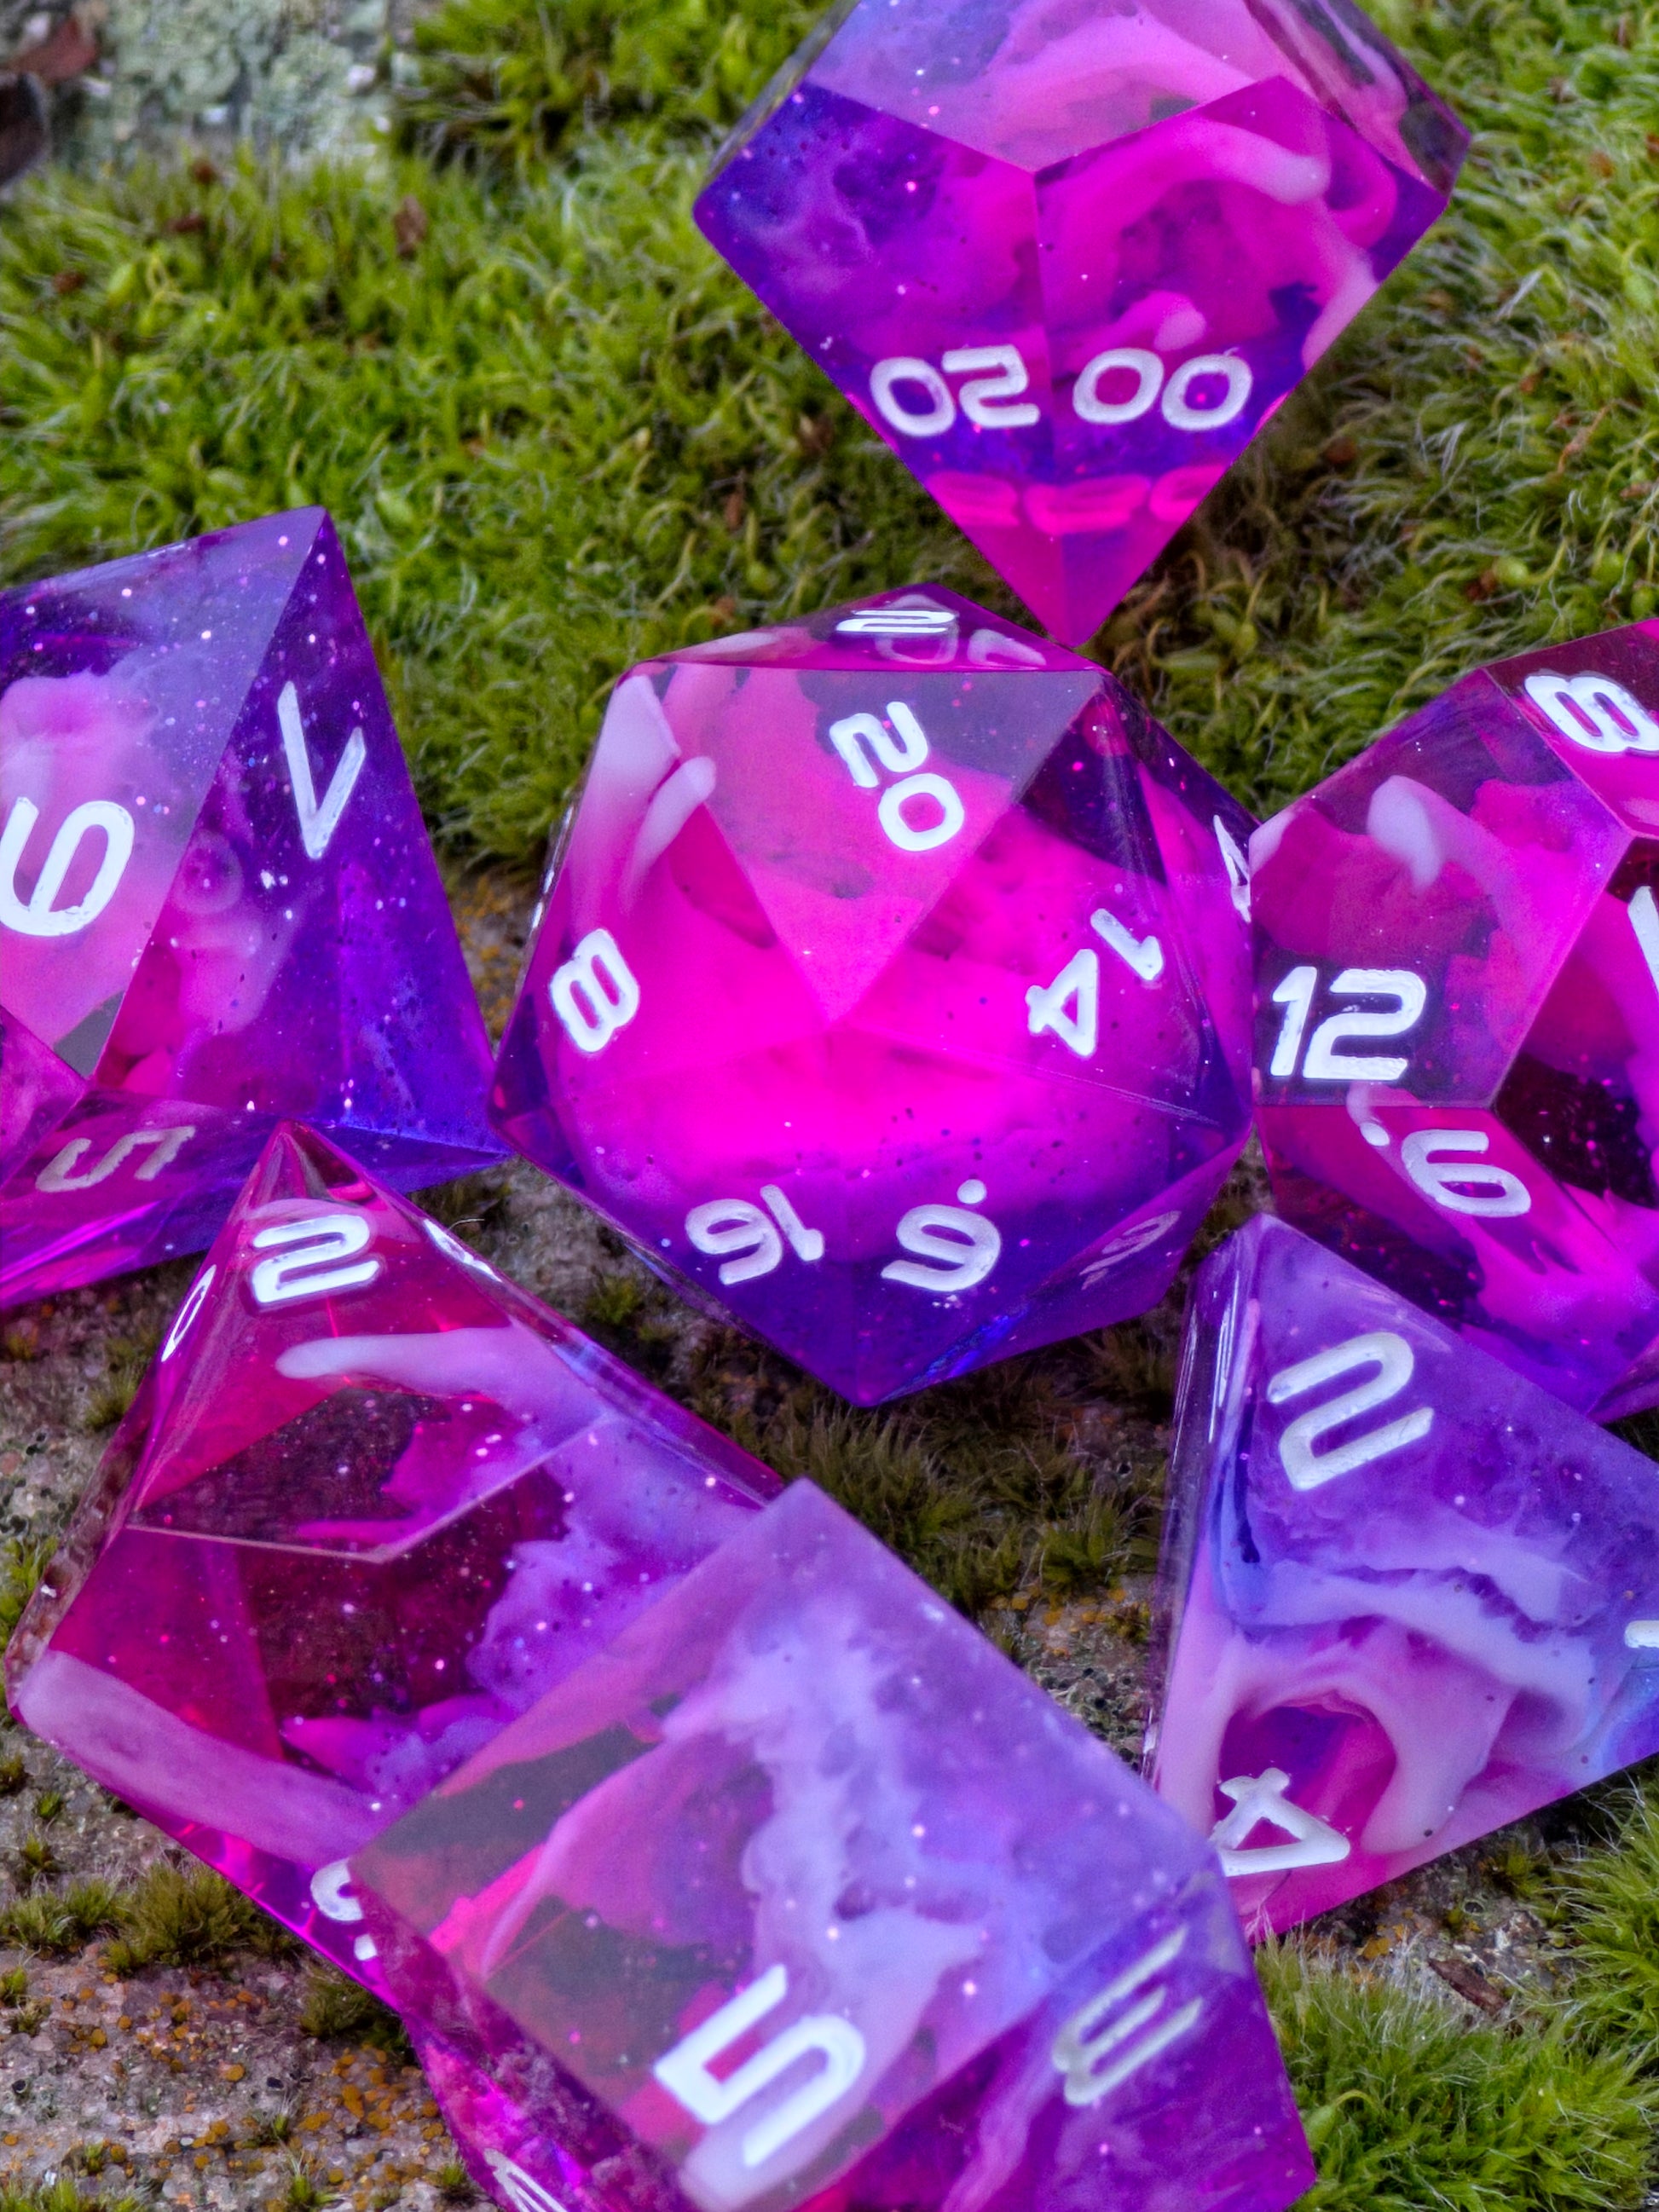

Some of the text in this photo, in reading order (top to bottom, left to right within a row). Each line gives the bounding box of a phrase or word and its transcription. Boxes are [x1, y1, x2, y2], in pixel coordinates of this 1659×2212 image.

[1072, 348, 1253, 430] 00
[1524, 675, 1659, 754] 8
[829, 701, 965, 852] 20
[548, 927, 641, 1054] 8
[1026, 907, 1164, 1058] 14
[1270, 965, 1427, 1081] 12
[253, 1214, 380, 1302] 2
[685, 1185, 825, 1285] 16
[1267, 1331, 1434, 1492] 2
[1211, 1767, 1350, 1876] 4
[653, 1962, 866, 2169] 5
